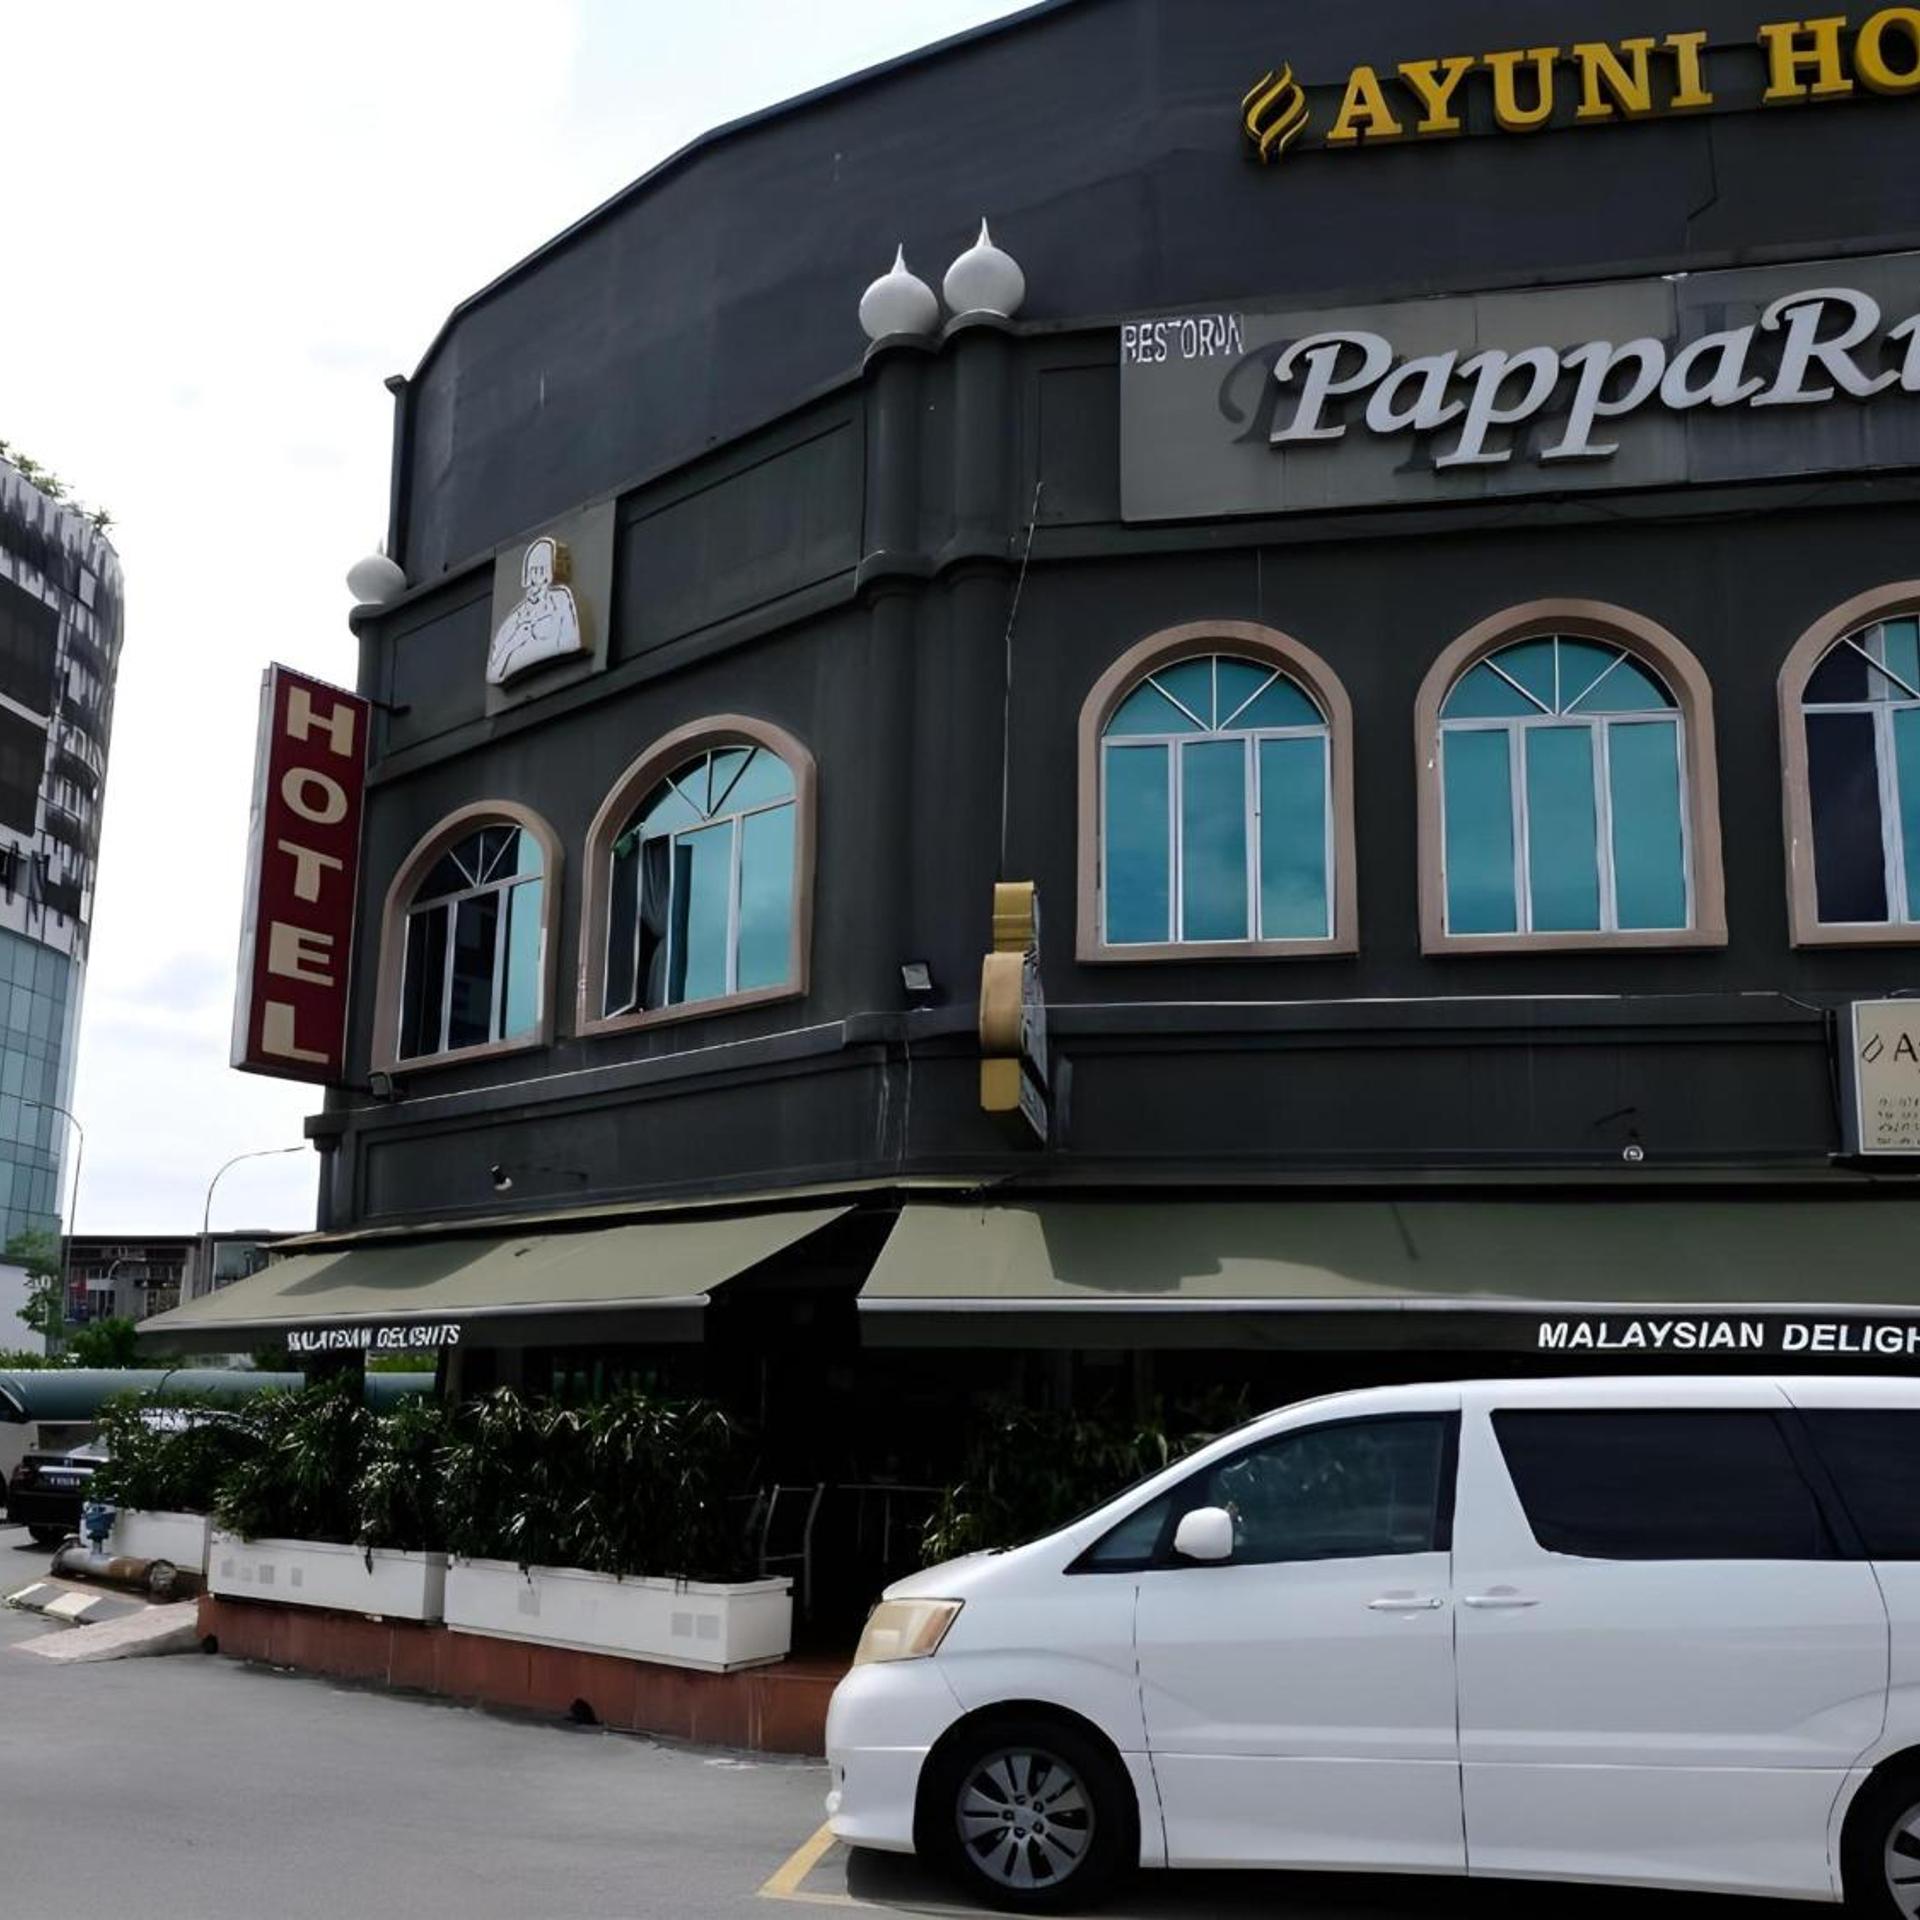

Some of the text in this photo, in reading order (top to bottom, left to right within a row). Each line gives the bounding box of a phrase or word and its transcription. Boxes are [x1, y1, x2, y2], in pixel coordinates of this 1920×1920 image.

[1326, 31, 1713, 142] AYUNI
[261, 685, 356, 1064] HOTEL
[1537, 1322, 1765, 1348] MALAYSIAN
